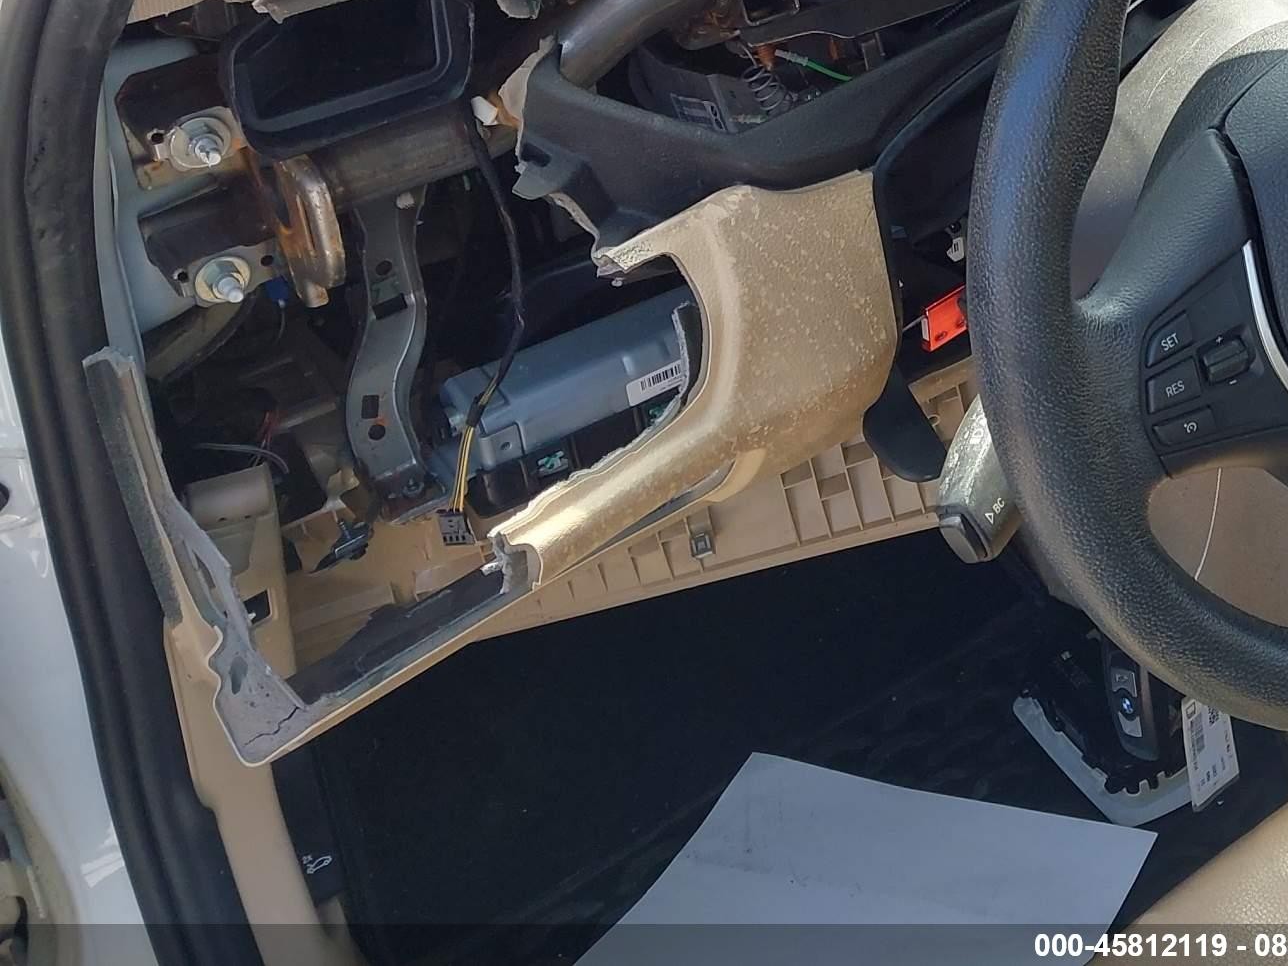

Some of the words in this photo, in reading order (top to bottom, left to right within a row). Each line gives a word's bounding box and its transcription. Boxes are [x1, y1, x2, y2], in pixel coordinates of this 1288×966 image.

[1161, 333, 1180, 351] SET
[1165, 380, 1185, 398] RES
[992, 497, 1005, 515] BC
